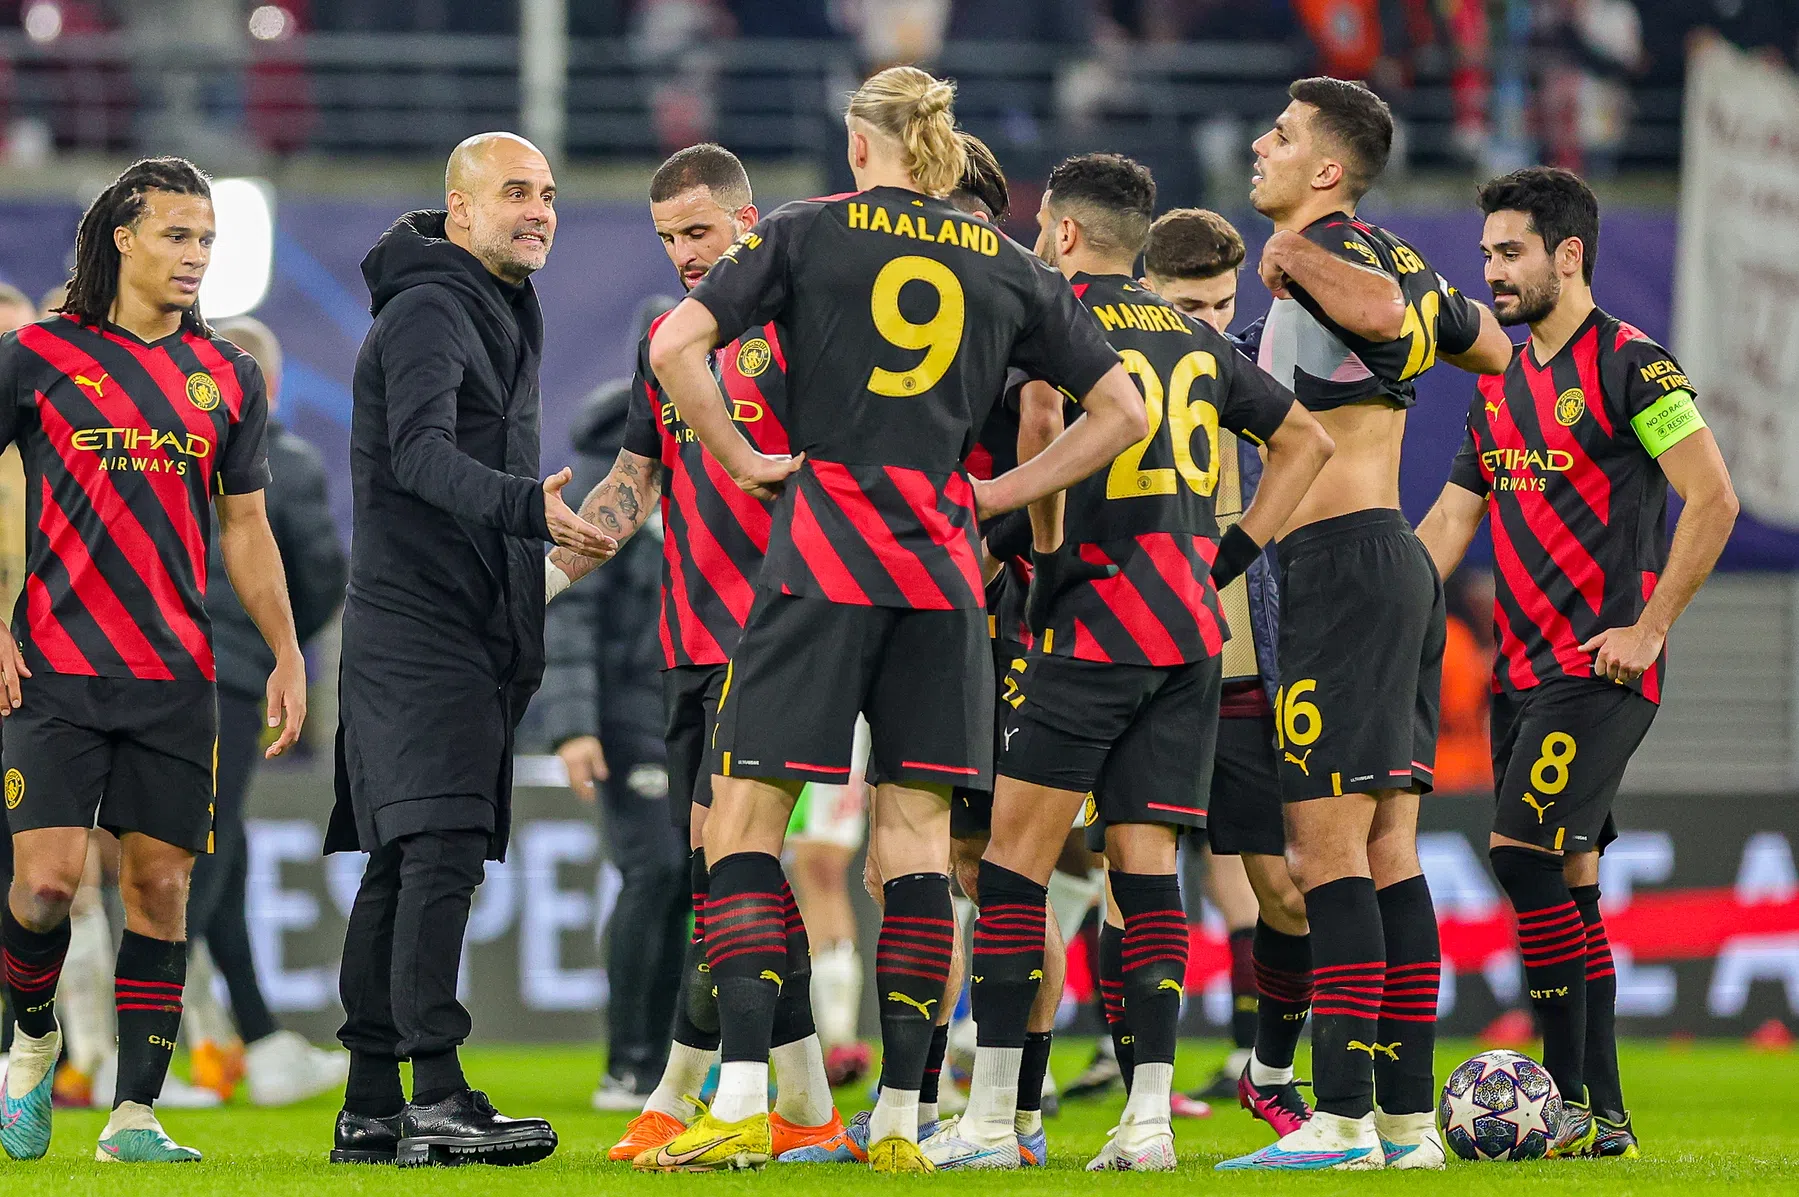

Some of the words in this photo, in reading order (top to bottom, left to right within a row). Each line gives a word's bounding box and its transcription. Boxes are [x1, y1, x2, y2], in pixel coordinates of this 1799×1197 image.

[848, 202, 999, 258] HAALAND
[866, 254, 966, 398] 9
[1105, 349, 1220, 500] 26
[1646, 417, 1658, 429] NO
[1658, 409, 1669, 420] TO
[70, 427, 210, 458] ETIHAD
[98, 456, 187, 476] AIRWAYS
[1481, 448, 1574, 472] ETIHAD
[1493, 476, 1547, 492] IRWAYS
[1273, 678, 1323, 748] 16
[1530, 731, 1577, 795] 8
[1529, 985, 1569, 999] CITY
